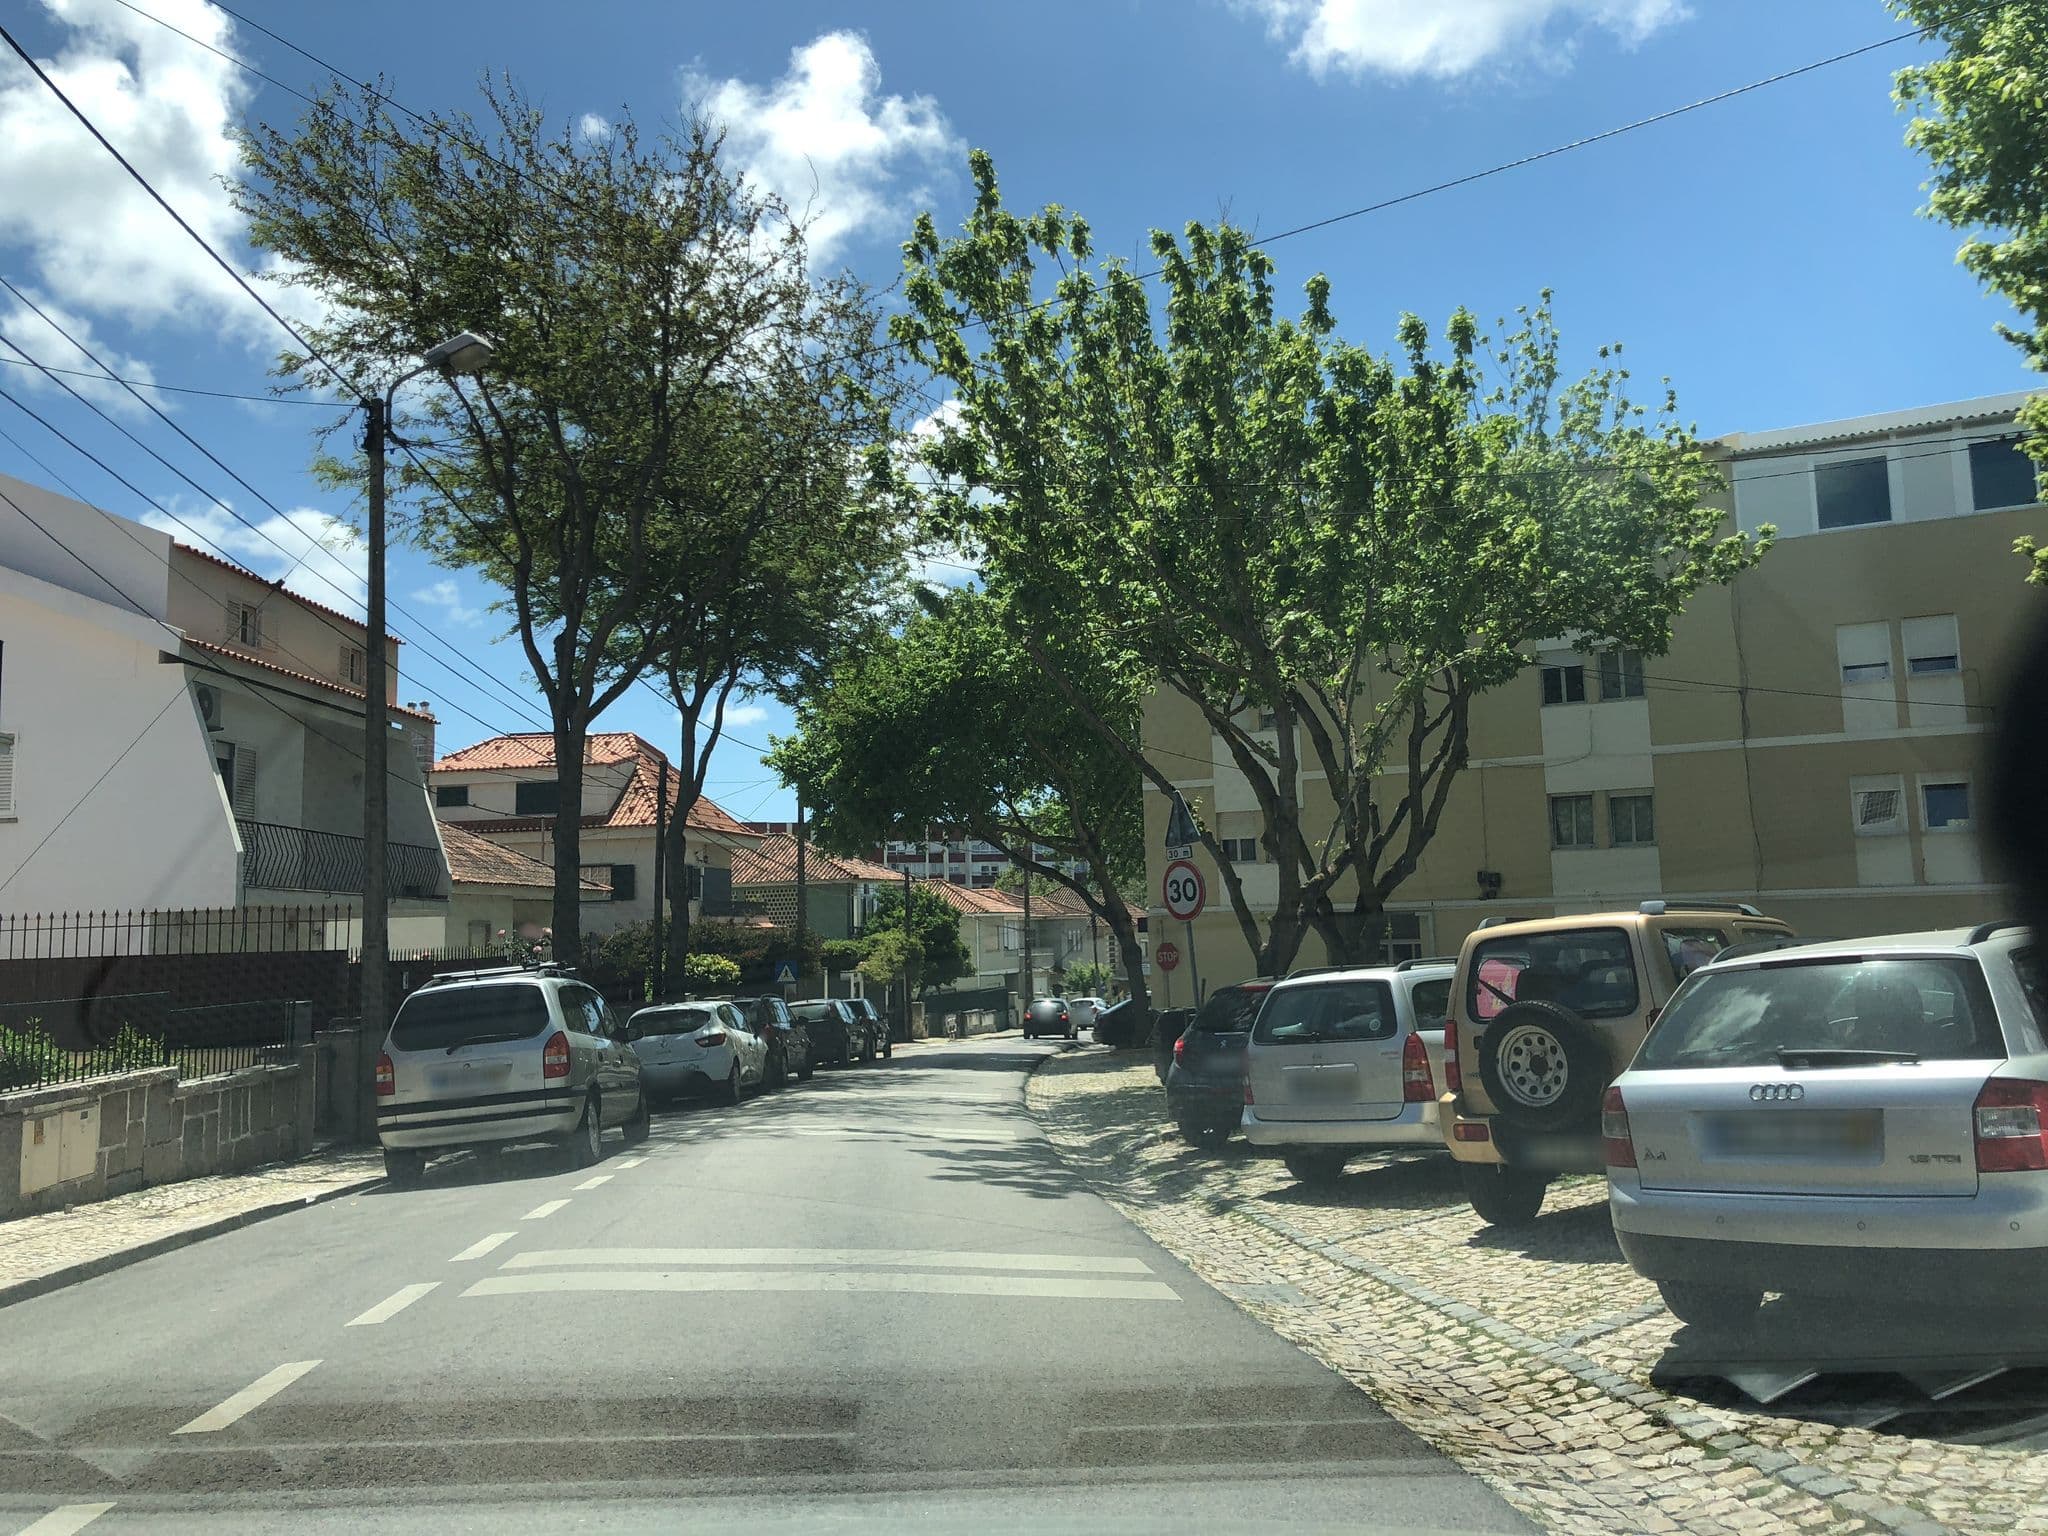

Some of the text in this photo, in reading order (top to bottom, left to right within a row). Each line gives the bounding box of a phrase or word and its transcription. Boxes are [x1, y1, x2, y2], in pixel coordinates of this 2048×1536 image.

[1168, 850, 1178, 858] 30
[1169, 878, 1197, 903] 30
[1158, 951, 1178, 962] STOP
